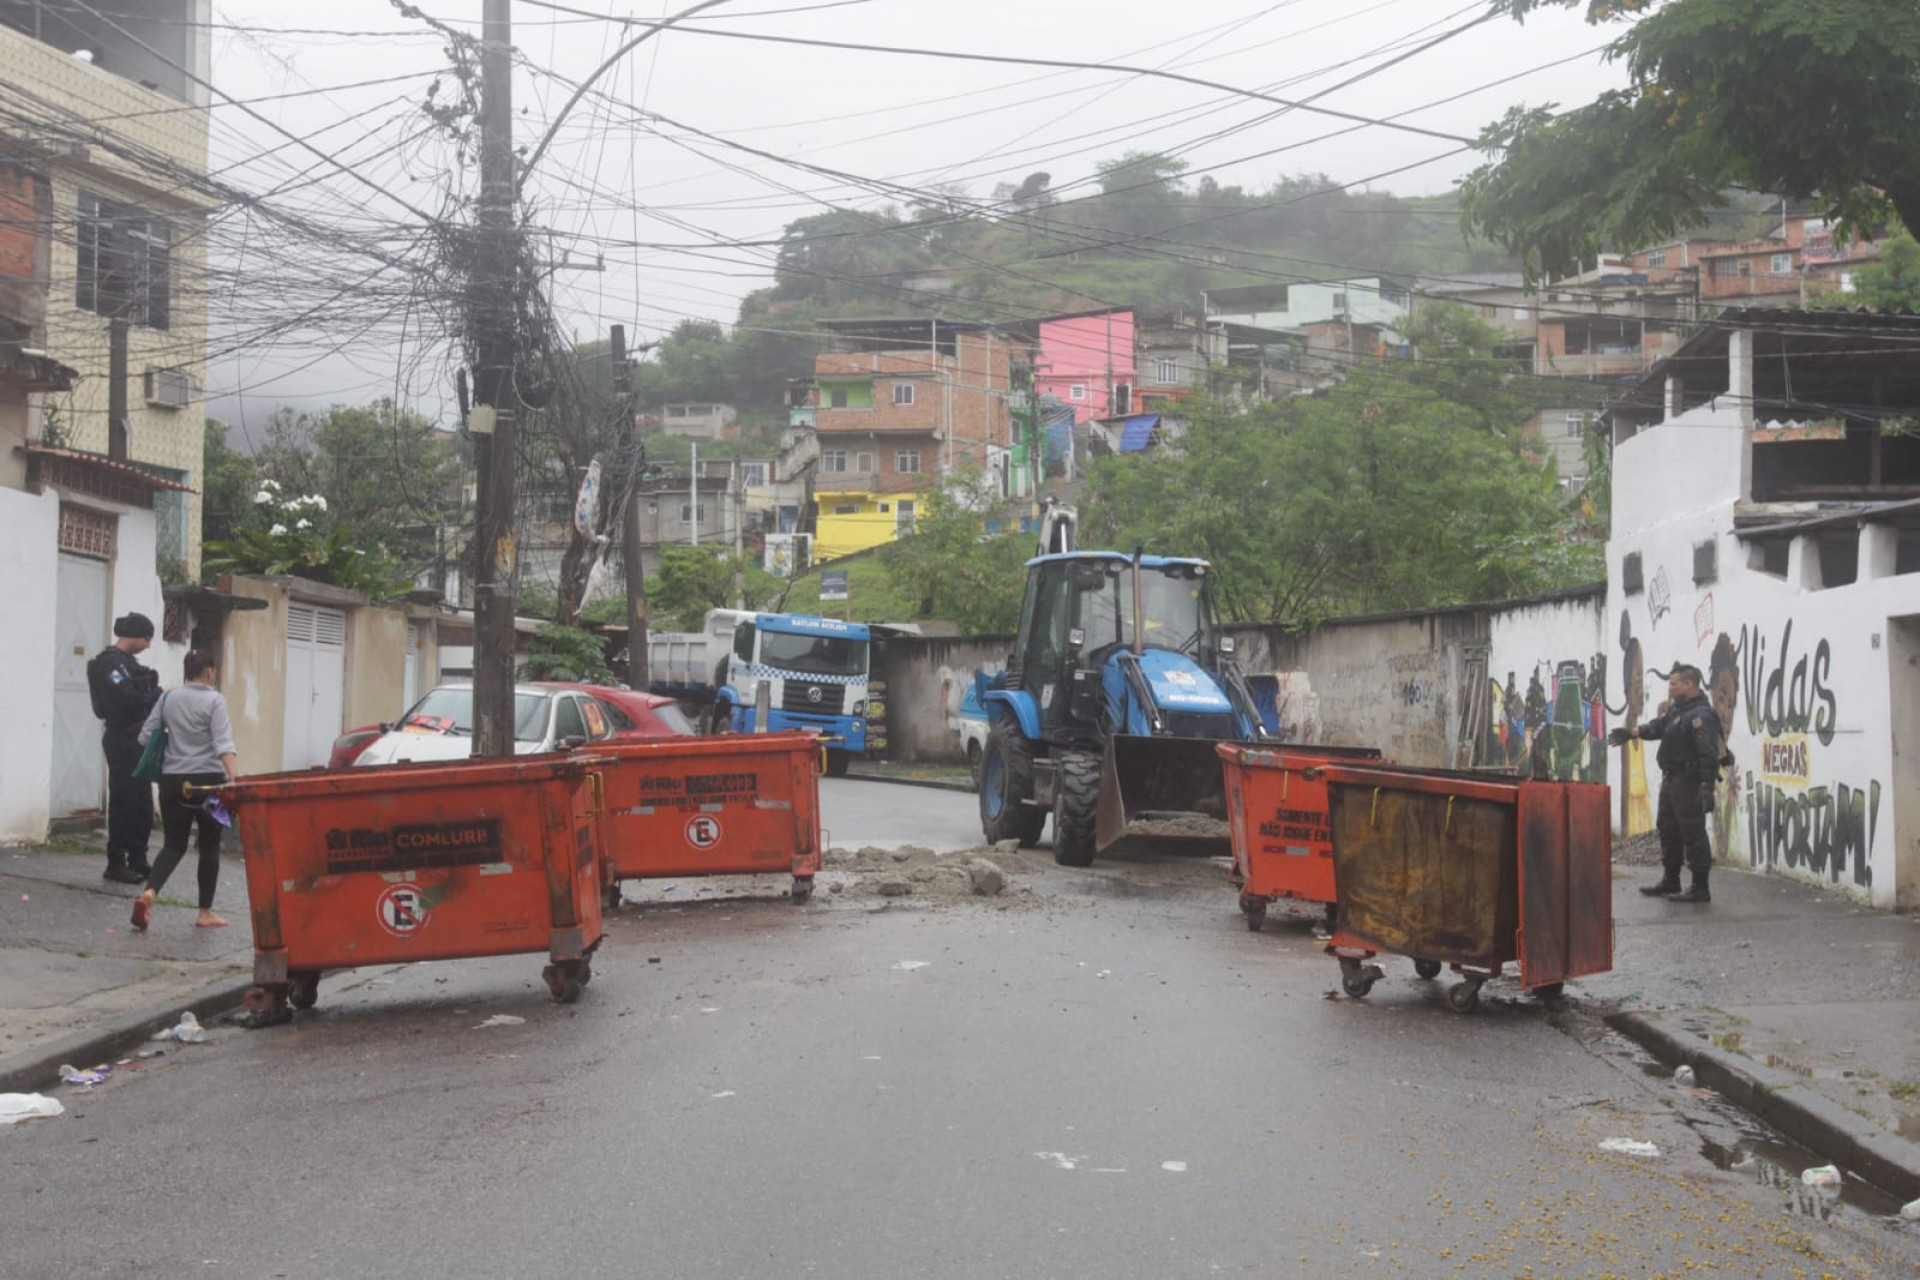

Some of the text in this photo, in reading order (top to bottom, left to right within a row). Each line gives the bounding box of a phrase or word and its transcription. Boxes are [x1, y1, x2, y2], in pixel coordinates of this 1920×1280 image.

[1736, 618, 1836, 746] Vidas
[1763, 741, 1807, 777] NEGRAS
[1260, 820, 1281, 837] NÃO
[1276, 808, 1323, 825] SOMENTE
